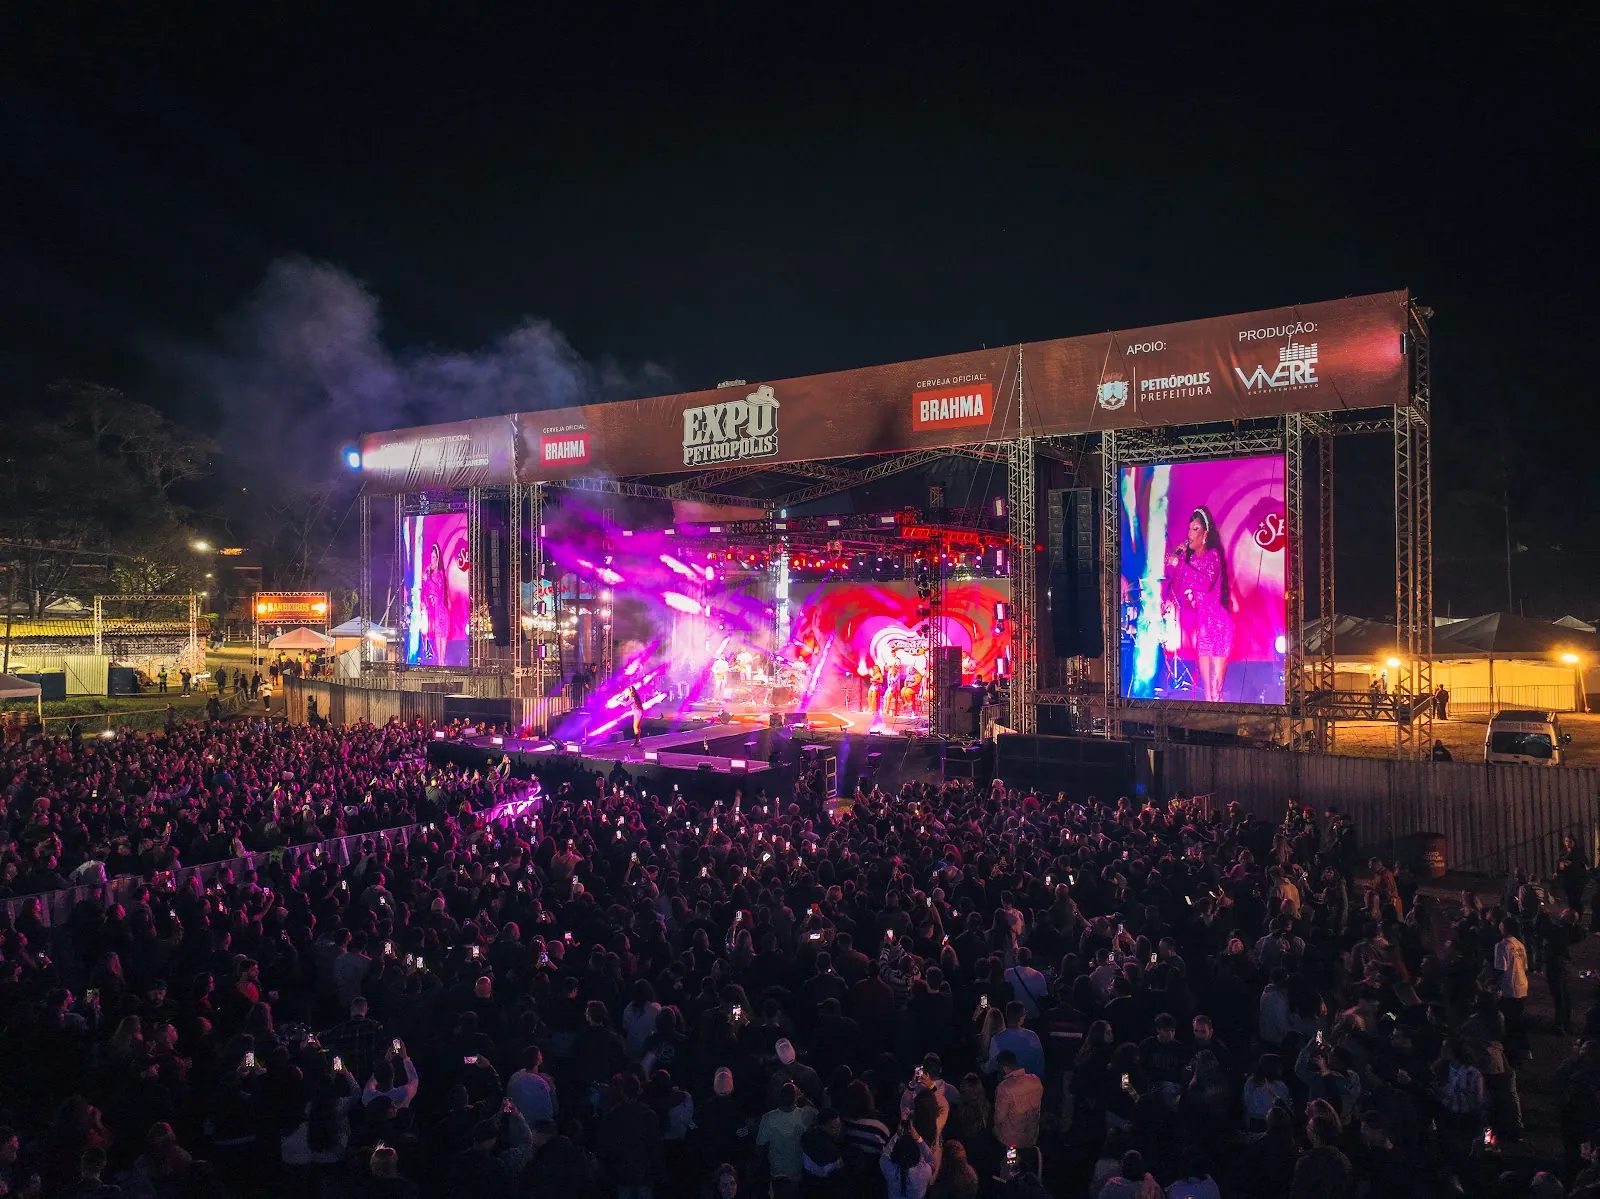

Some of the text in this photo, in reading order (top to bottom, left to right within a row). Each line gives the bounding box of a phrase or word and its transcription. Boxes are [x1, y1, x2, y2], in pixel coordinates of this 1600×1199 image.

[1239, 321, 1318, 341] PRODUÇÃO:
[1126, 340, 1167, 356] APOIO:
[916, 373, 987, 389] CERVEJA OFICIAL:
[1141, 372, 1211, 392] PETRÓPOLIS
[1141, 386, 1213, 402] PREFEITURA
[920, 393, 984, 422] BRAHMA
[683, 397, 778, 448] EXPO
[545, 439, 586, 460] BRAHMA
[465, 458, 489, 468] JANEIRO
[267, 602, 310, 612] BANHEIROS
